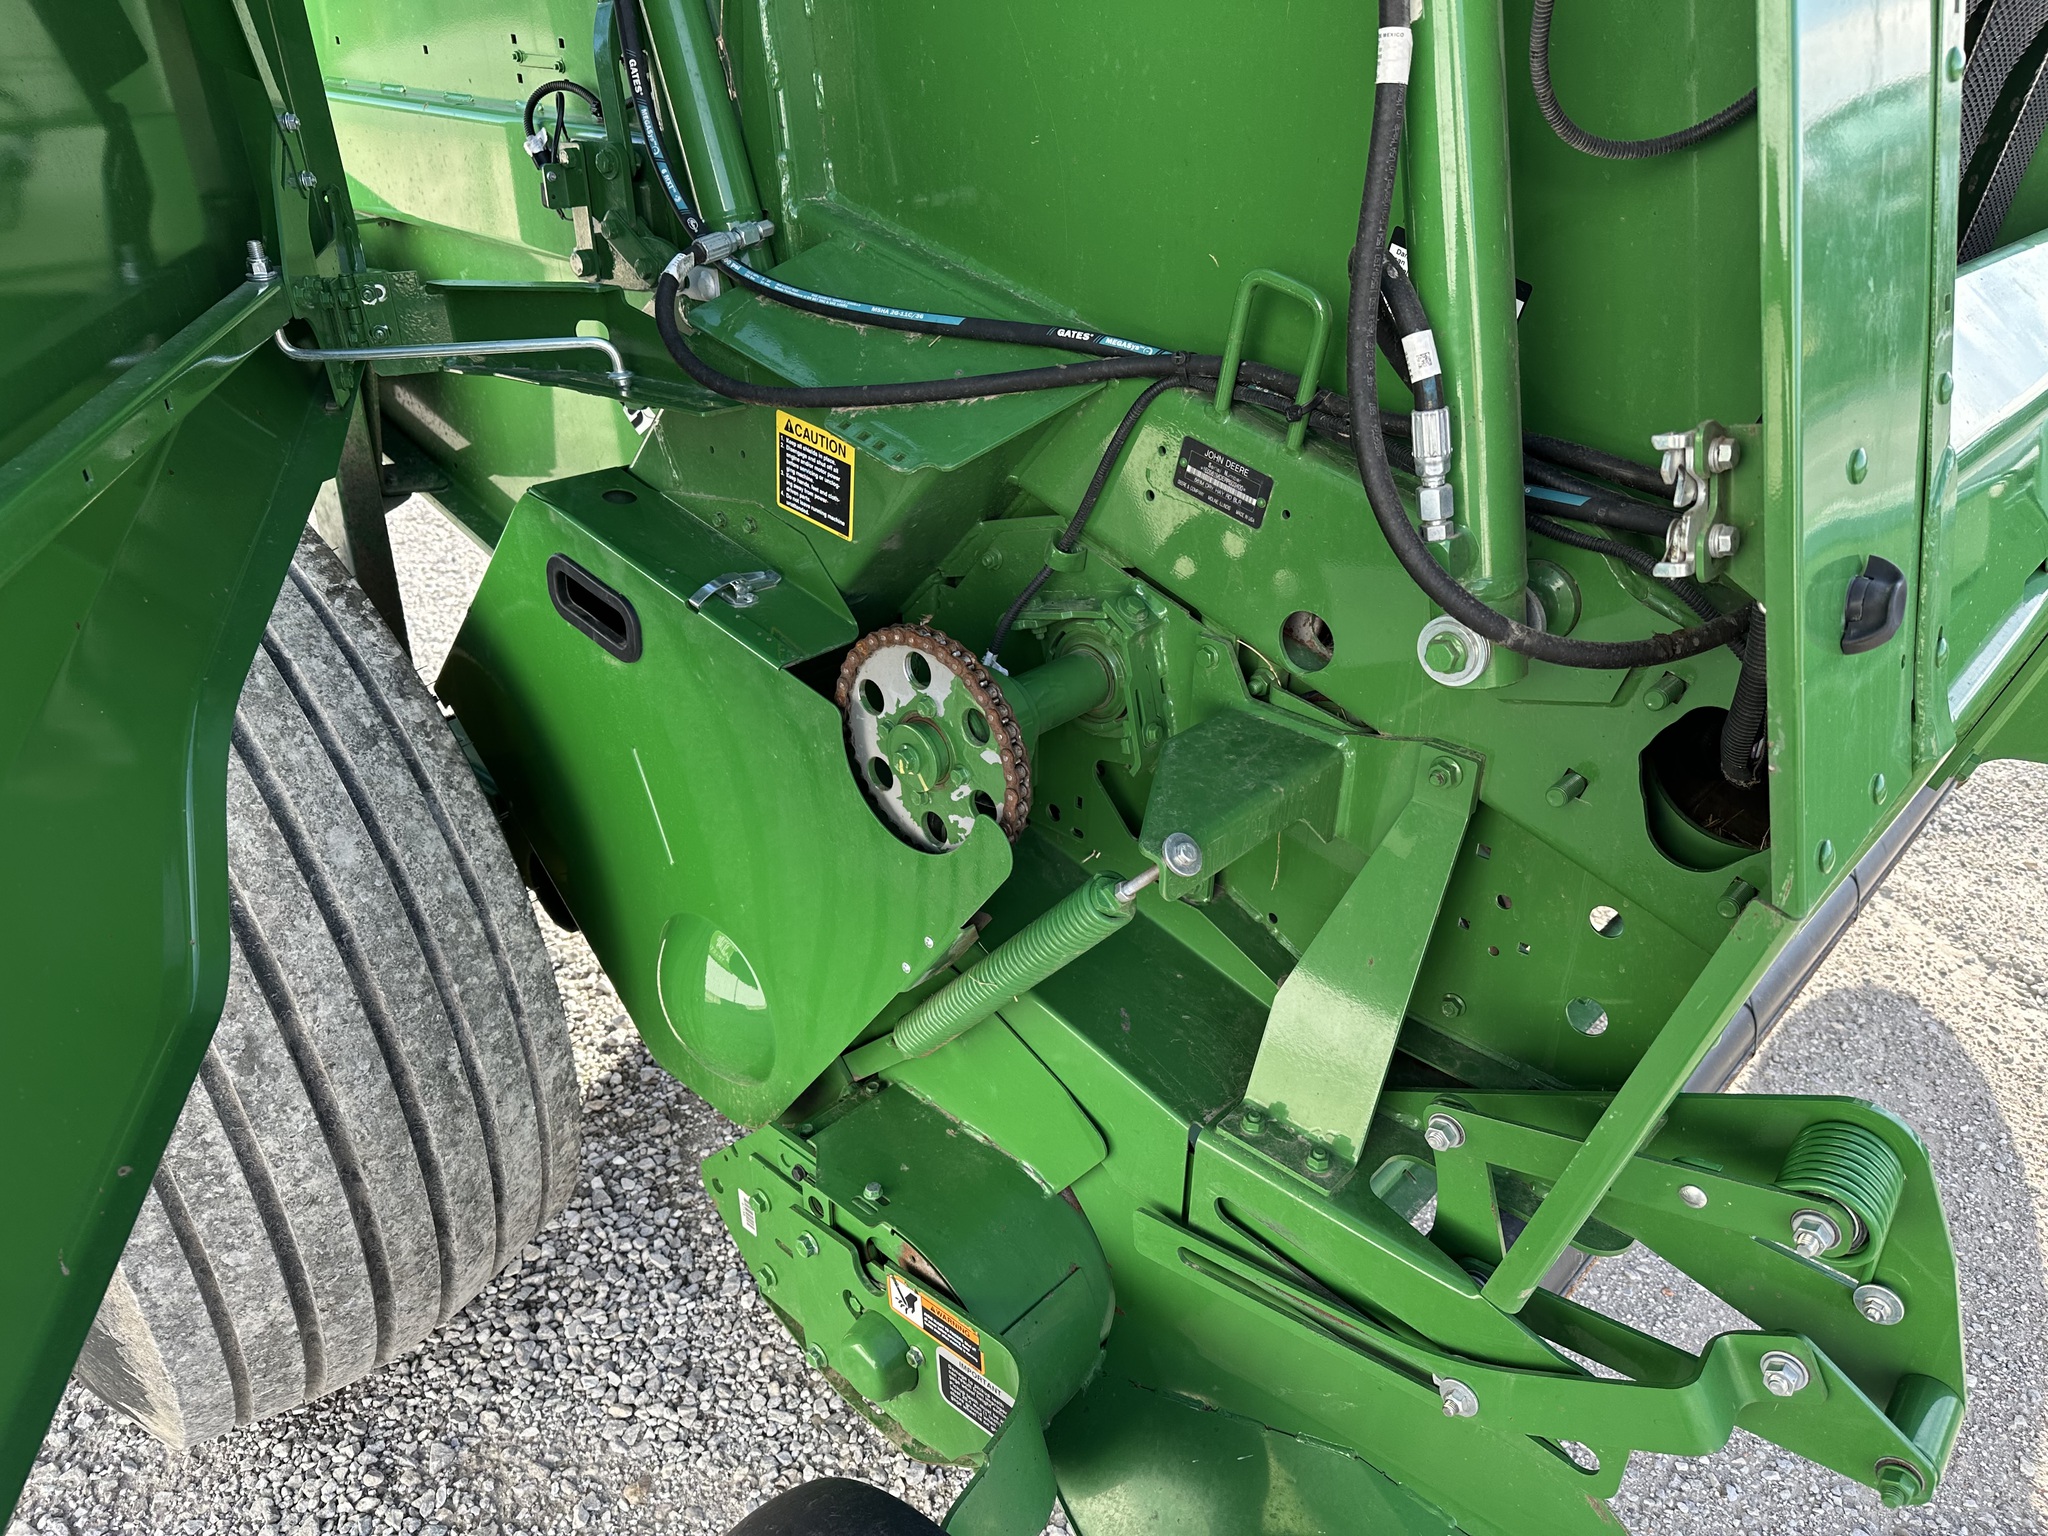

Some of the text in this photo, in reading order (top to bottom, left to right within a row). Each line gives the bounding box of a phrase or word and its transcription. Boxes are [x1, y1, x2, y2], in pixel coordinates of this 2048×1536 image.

[628, 58, 644, 96] GATES
[871, 306, 888, 315] MSHA
[1057, 328, 1090, 341] GATES
[795, 423, 846, 459] CAUTION
[1204, 449, 1250, 478] JOHN DEERE
[936, 1309, 971, 1337] WARNING
[959, 1361, 1001, 1396] IMPORTANT
